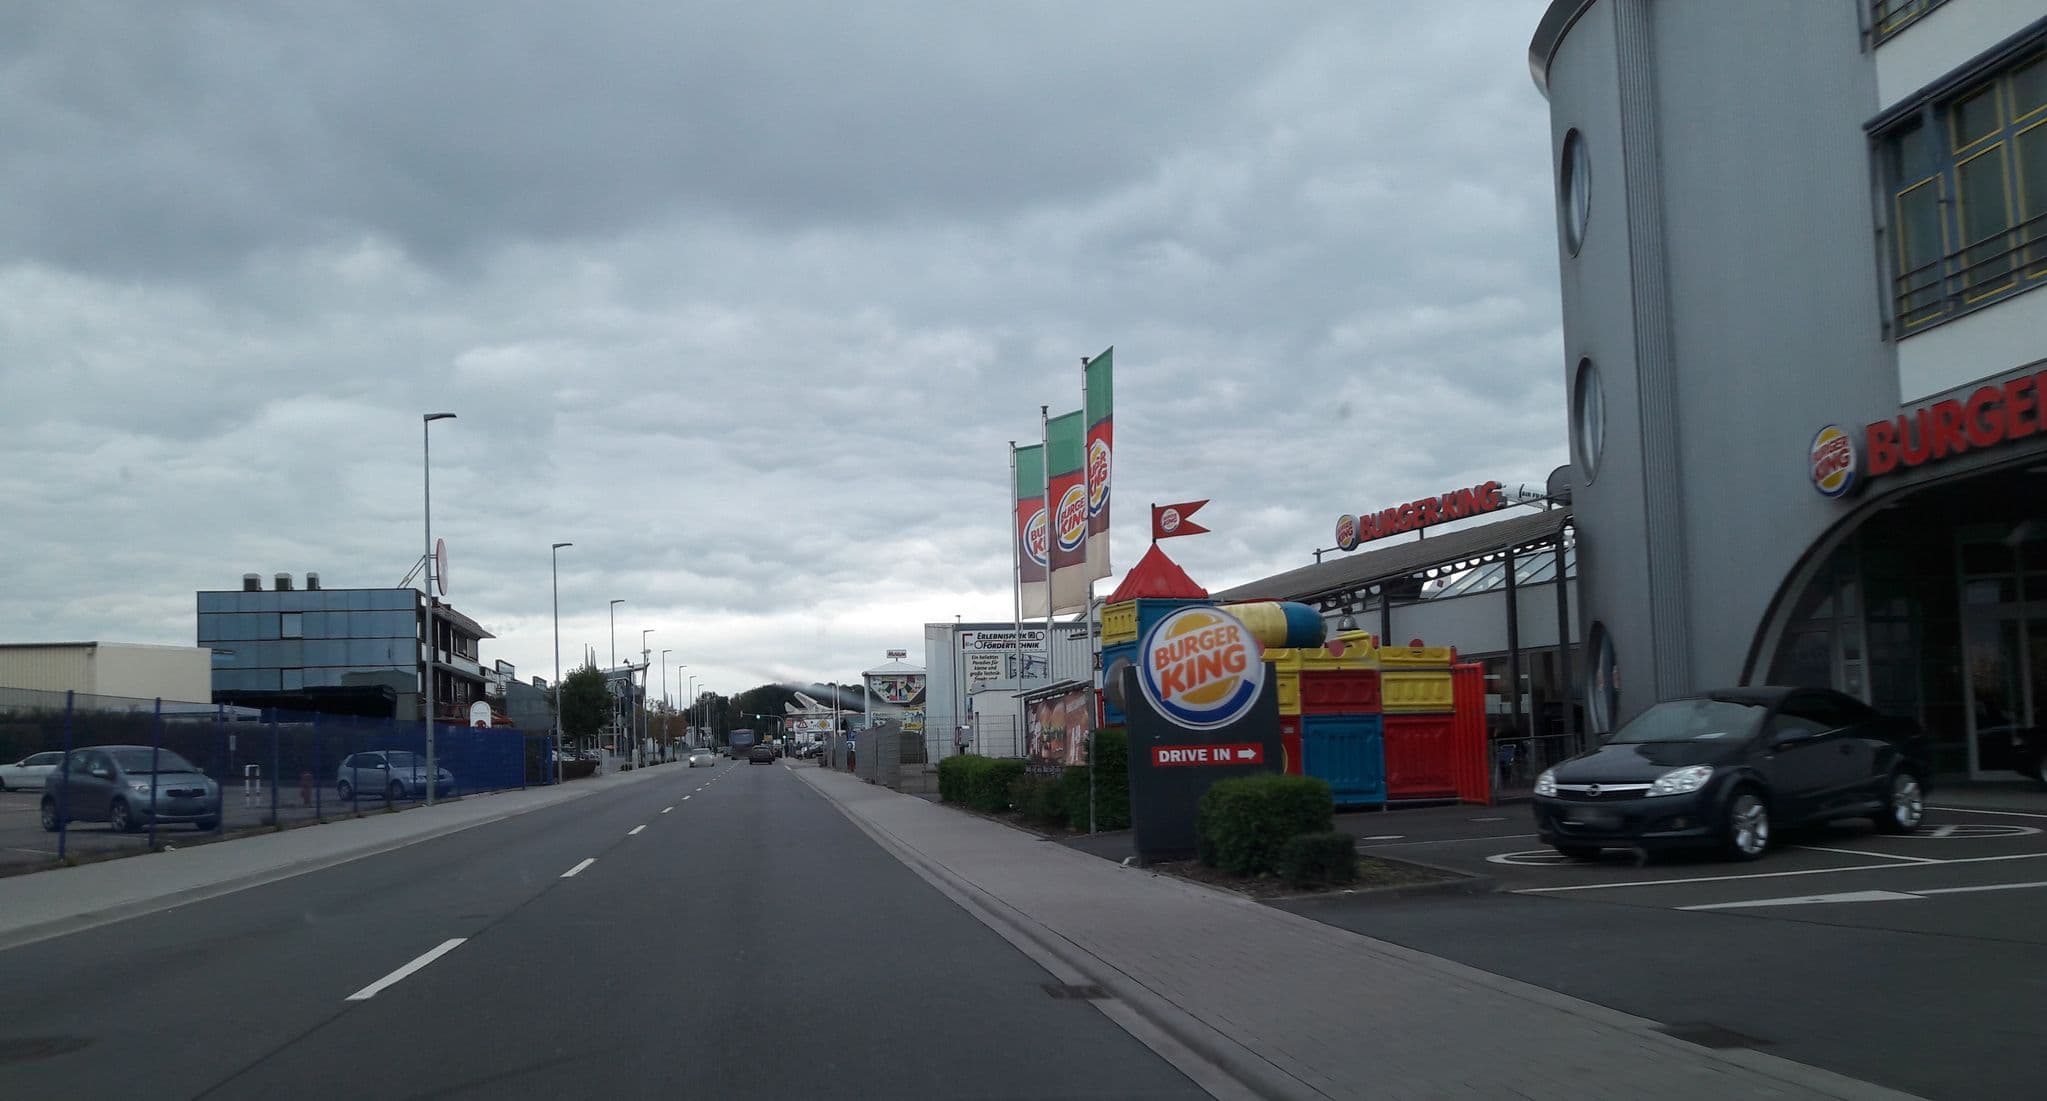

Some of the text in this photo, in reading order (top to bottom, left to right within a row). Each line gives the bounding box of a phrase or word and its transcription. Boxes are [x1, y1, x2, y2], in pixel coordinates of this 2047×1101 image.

[1061, 497, 1086, 523] BURGE
[1360, 481, 1503, 541] BURGER KING
[1154, 624, 1241, 671] BURGER
[1160, 643, 1247, 701] KING
[1158, 748, 1231, 763] DRIVE IN
